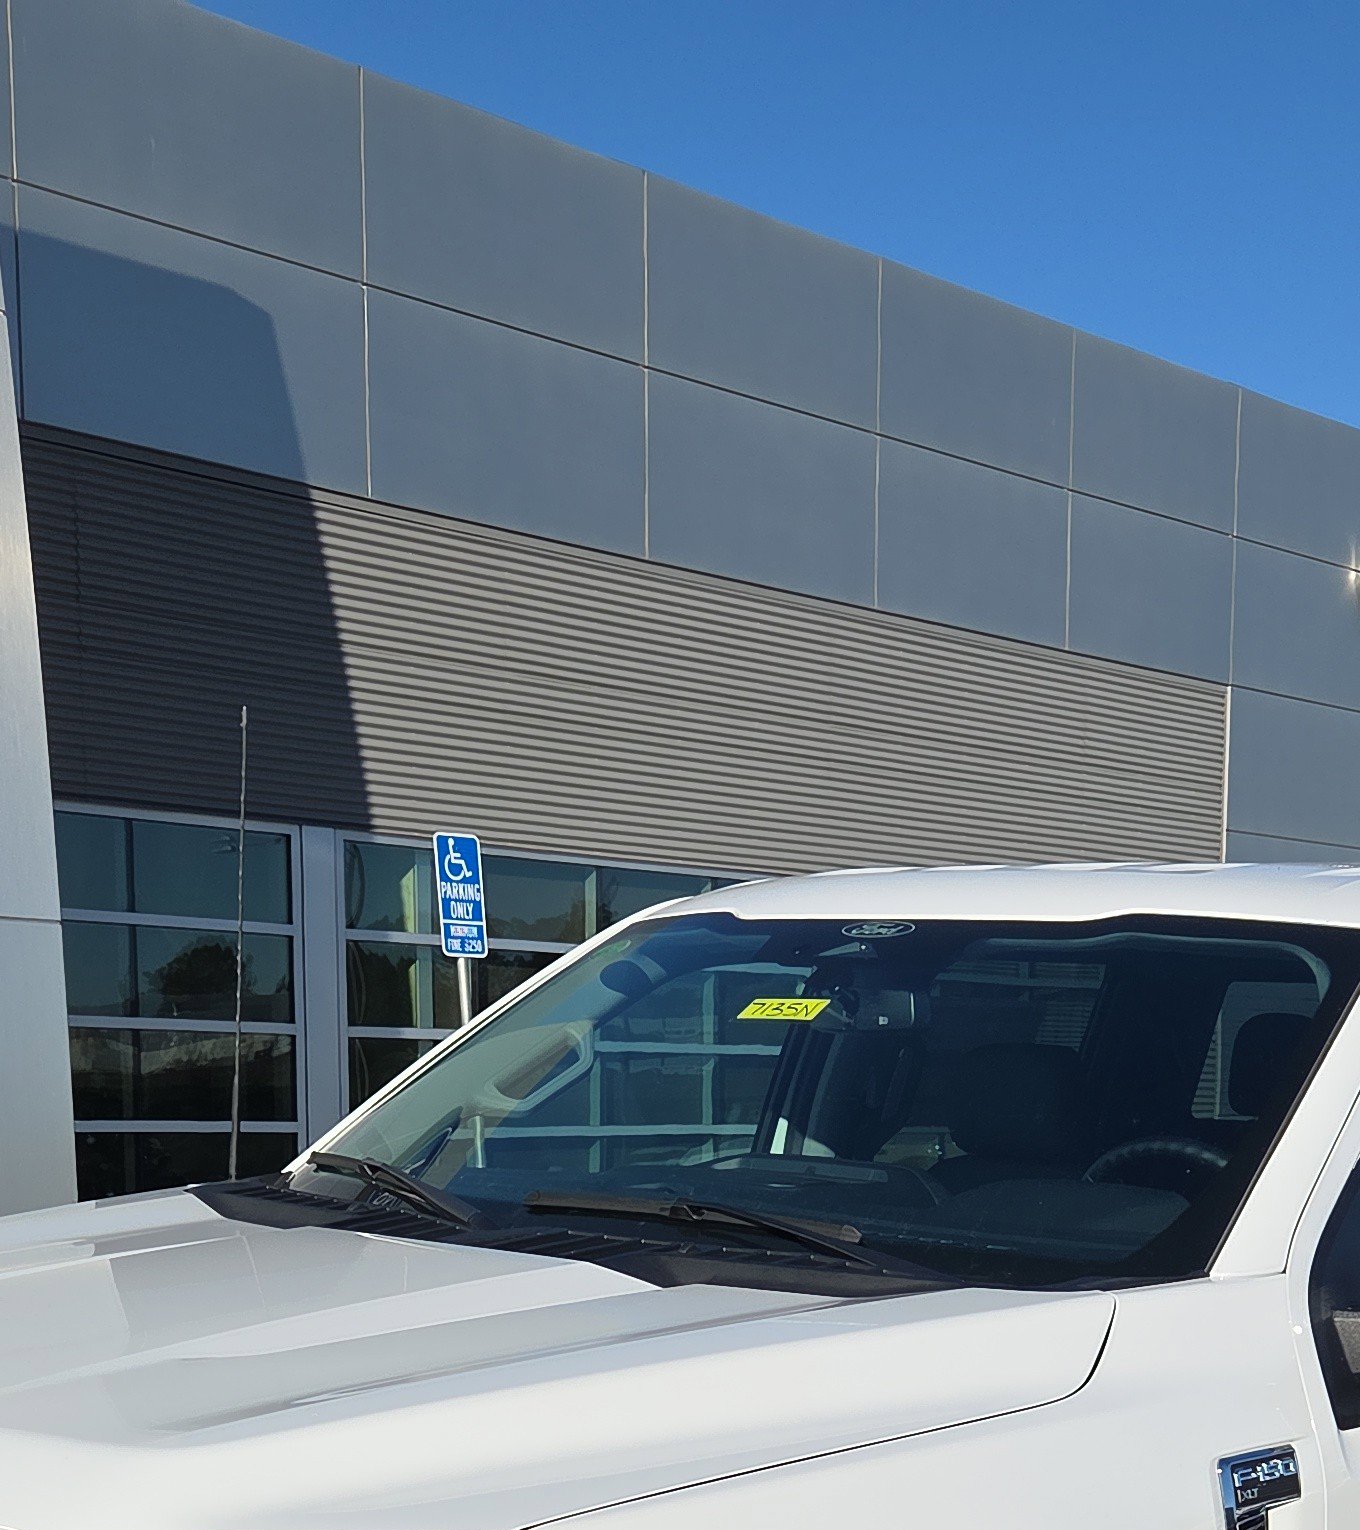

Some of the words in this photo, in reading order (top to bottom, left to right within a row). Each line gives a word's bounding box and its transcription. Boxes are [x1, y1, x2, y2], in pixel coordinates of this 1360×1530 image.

[441, 882, 481, 901] PARKING
[450, 901, 473, 919] ONLY
[1233, 1458, 1297, 1487] F-150
[1242, 1488, 1259, 1501] XLT
